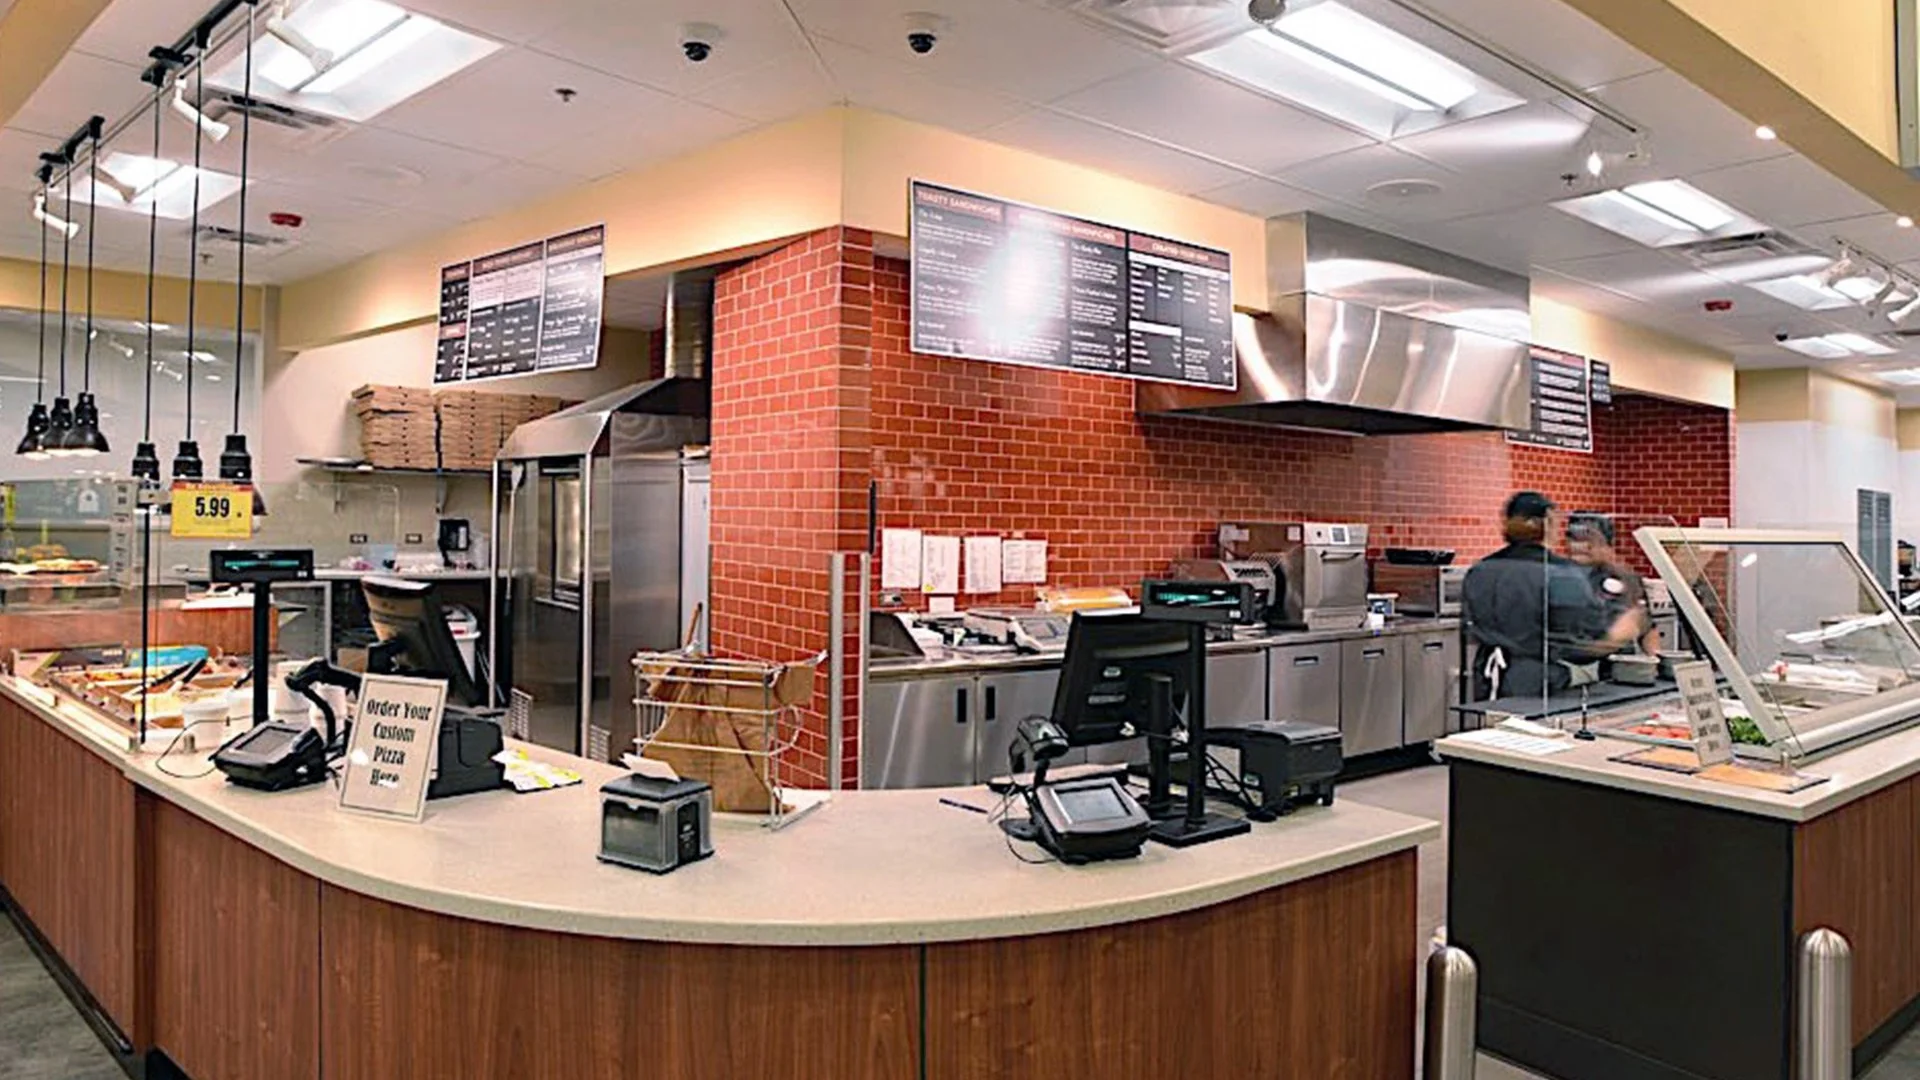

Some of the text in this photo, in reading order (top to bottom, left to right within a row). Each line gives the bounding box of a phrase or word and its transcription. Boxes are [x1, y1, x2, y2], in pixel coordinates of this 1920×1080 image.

[195, 496, 230, 518] 5.99
[366, 698, 432, 721] Order Your
[373, 722, 416, 743] Custom
[373, 745, 406, 765] Pizza
[370, 768, 400, 786] Here
